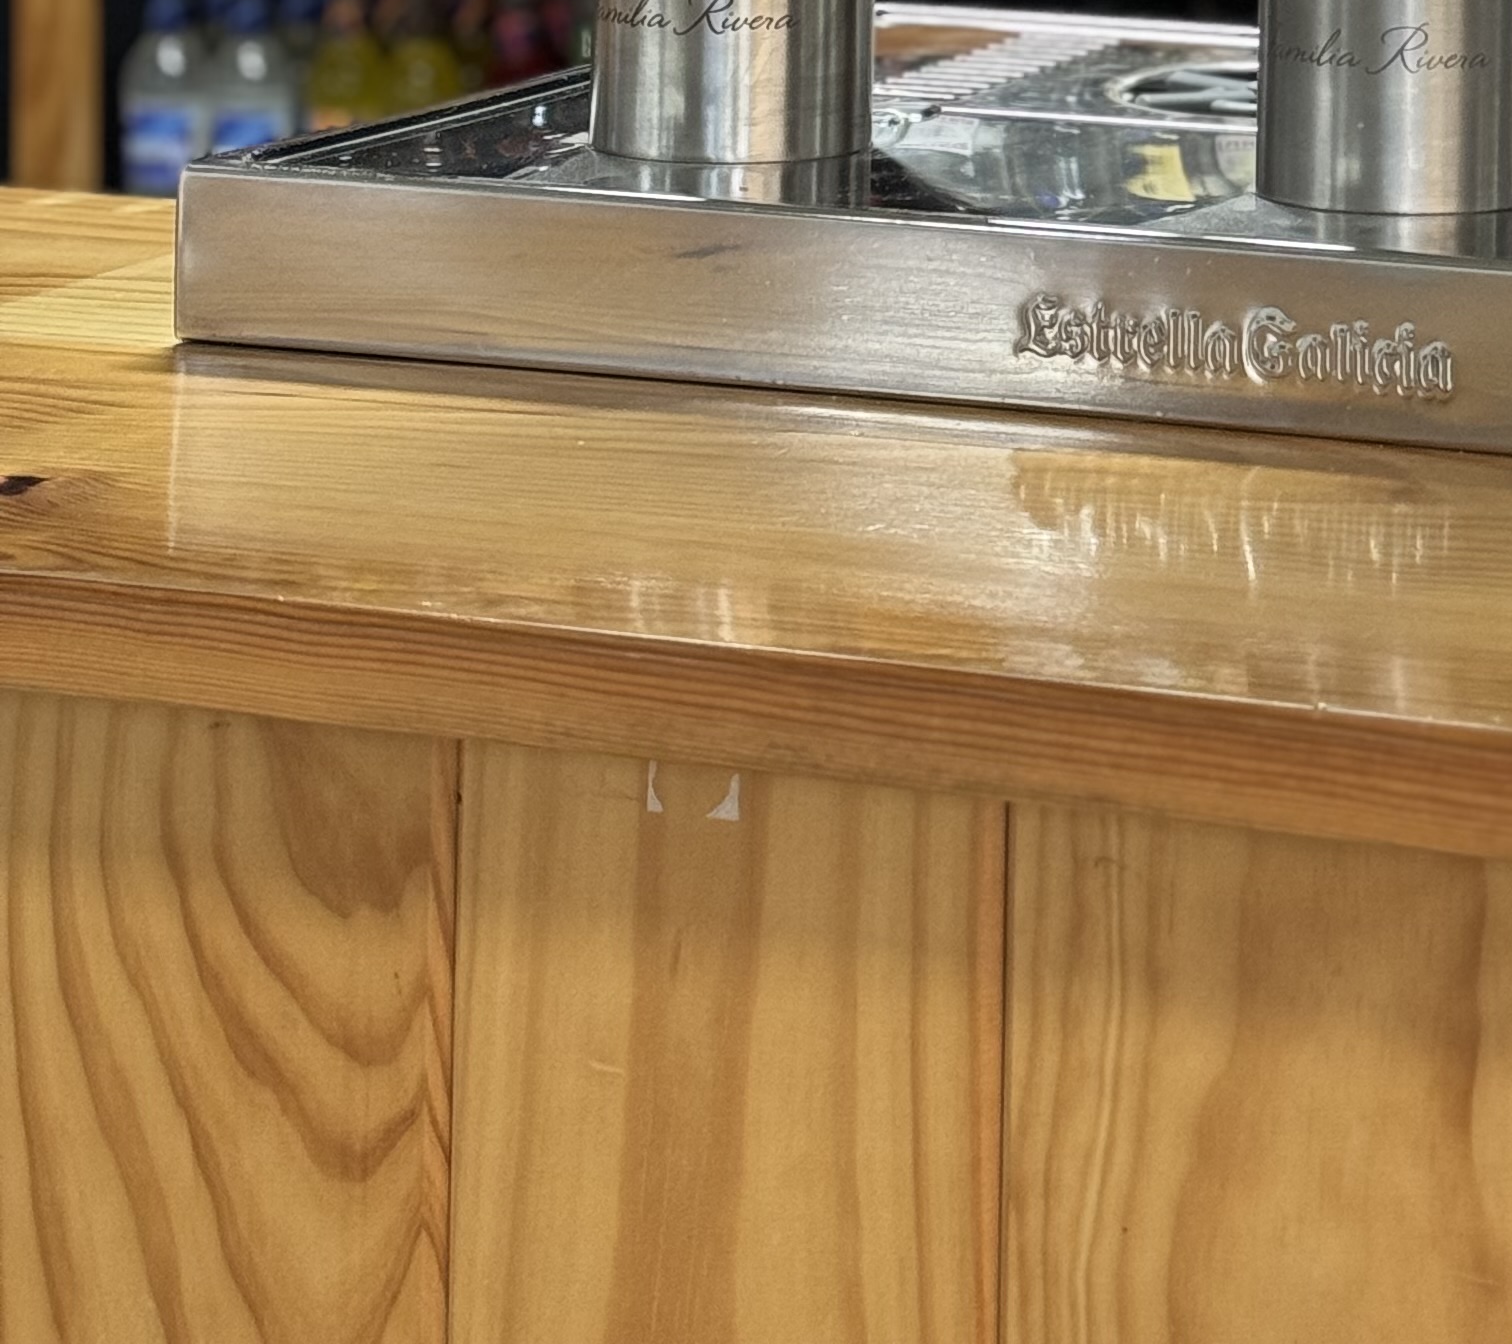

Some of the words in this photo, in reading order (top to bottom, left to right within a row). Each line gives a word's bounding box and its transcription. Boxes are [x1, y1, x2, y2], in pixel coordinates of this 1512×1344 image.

[1365, 23, 1490, 75] Rivera
[1014, 291, 1237, 379] Estrella
[1242, 306, 1455, 399] Galicia
